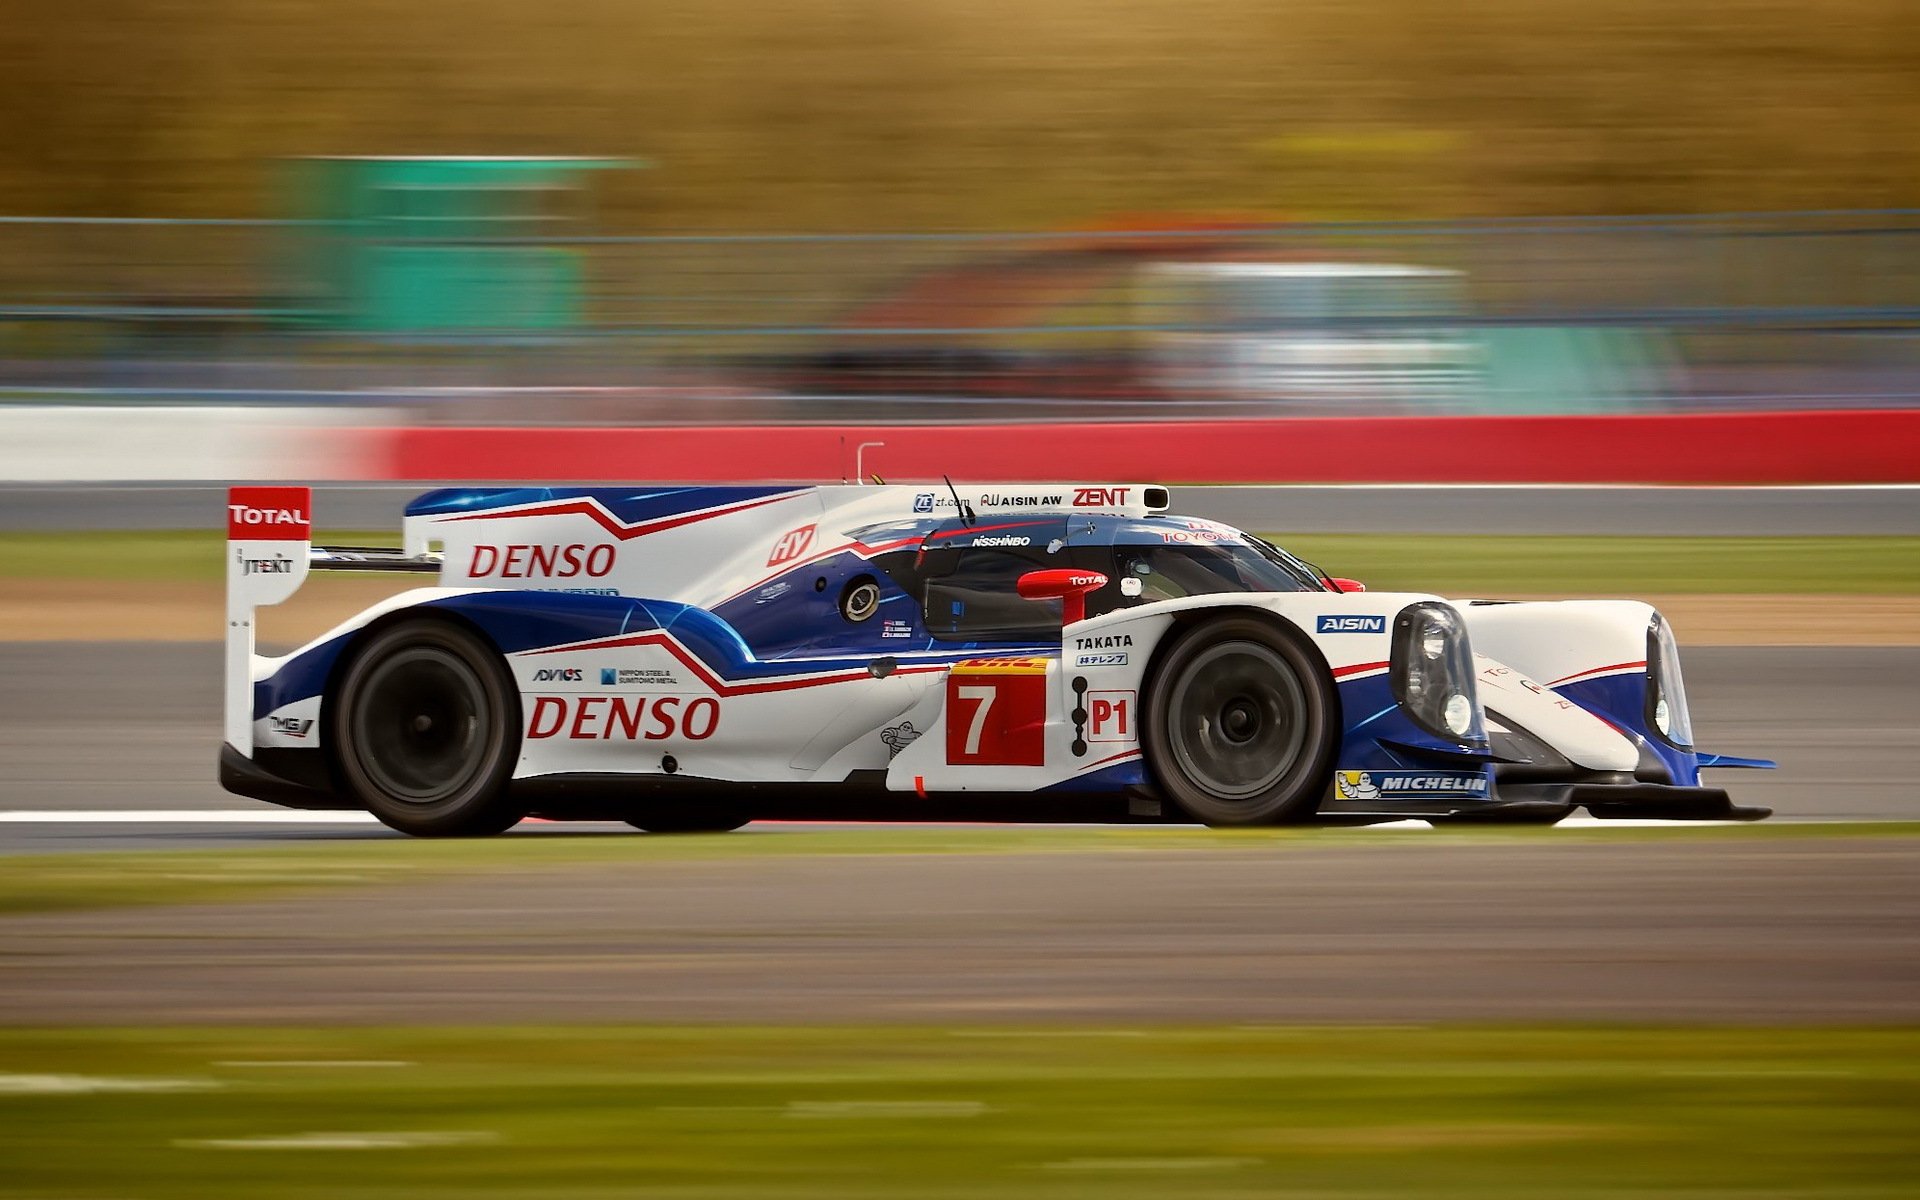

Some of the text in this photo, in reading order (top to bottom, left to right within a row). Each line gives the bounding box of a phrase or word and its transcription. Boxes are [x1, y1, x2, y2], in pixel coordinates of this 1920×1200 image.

[935, 497, 970, 507] zf.com
[1001, 497, 1039, 506] AISIN
[1041, 496, 1062, 505] AW
[1073, 488, 1130, 506] ZENT
[228, 504, 310, 525] TOTAL
[243, 559, 294, 576] JTEKT
[468, 544, 617, 578] DENSO
[1069, 576, 1108, 585] TOTAL
[1322, 618, 1382, 630] AISIN
[1076, 635, 1133, 650] TAKATA
[527, 697, 720, 740] DENSO
[958, 686, 997, 754] 7
[1092, 700, 1127, 734] P1
[1381, 777, 1487, 791] MICHELIN
